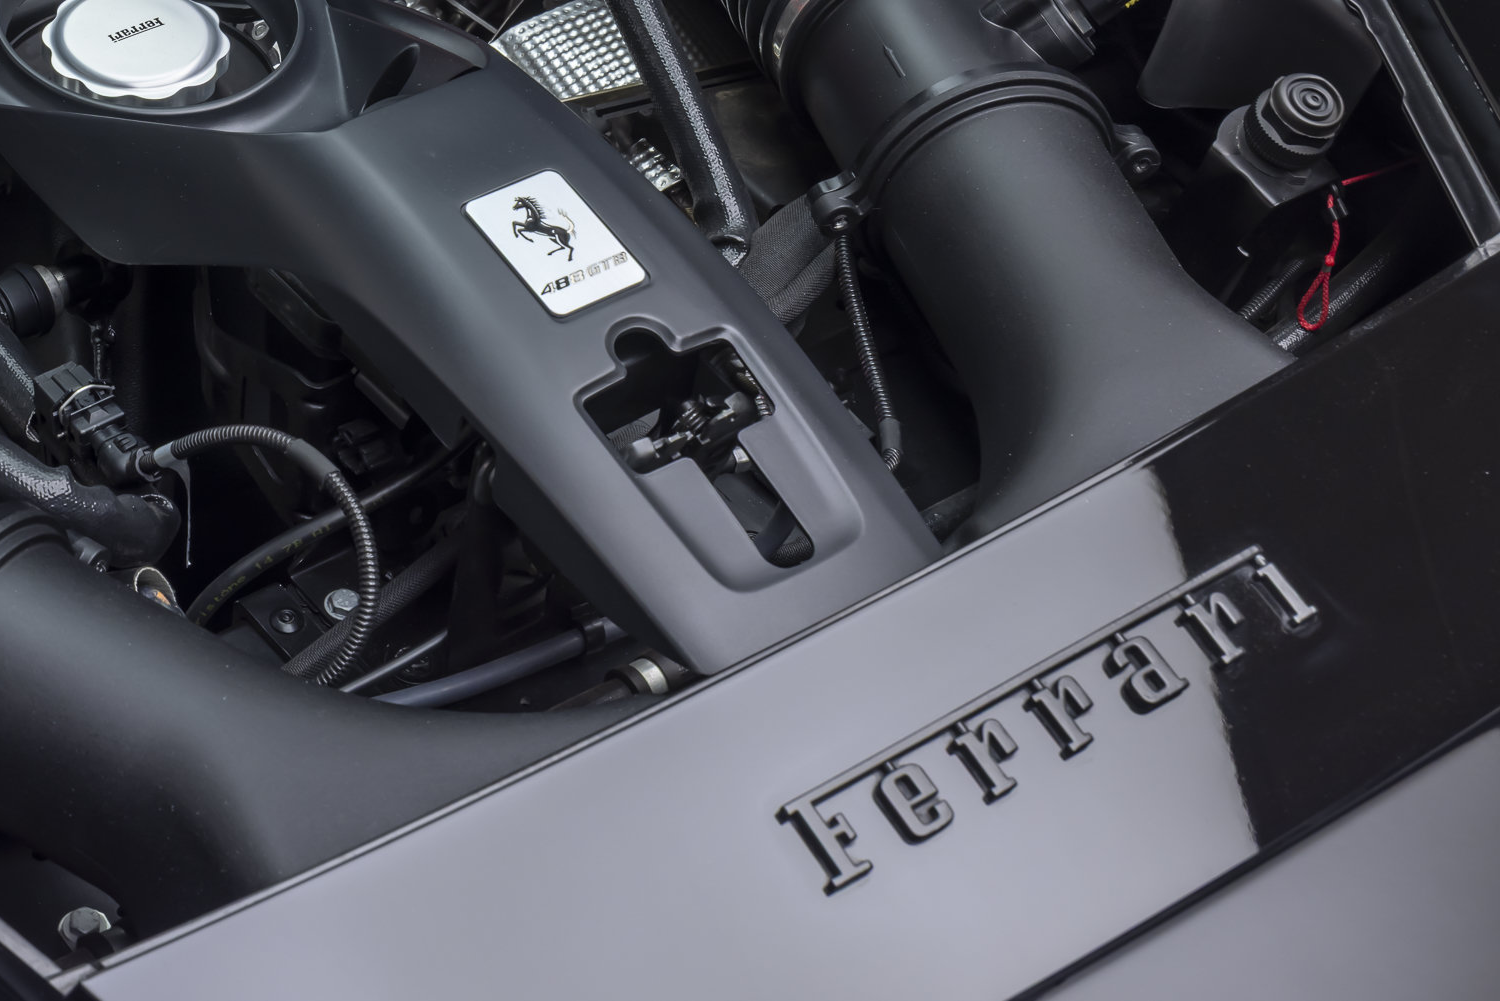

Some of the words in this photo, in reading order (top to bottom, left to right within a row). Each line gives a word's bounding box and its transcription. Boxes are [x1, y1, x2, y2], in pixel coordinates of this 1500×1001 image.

[107, 17, 165, 43] Ferrari
[541, 270, 585, 295] 488
[587, 252, 628, 277] GTB
[774, 544, 1318, 896] Ferrari
